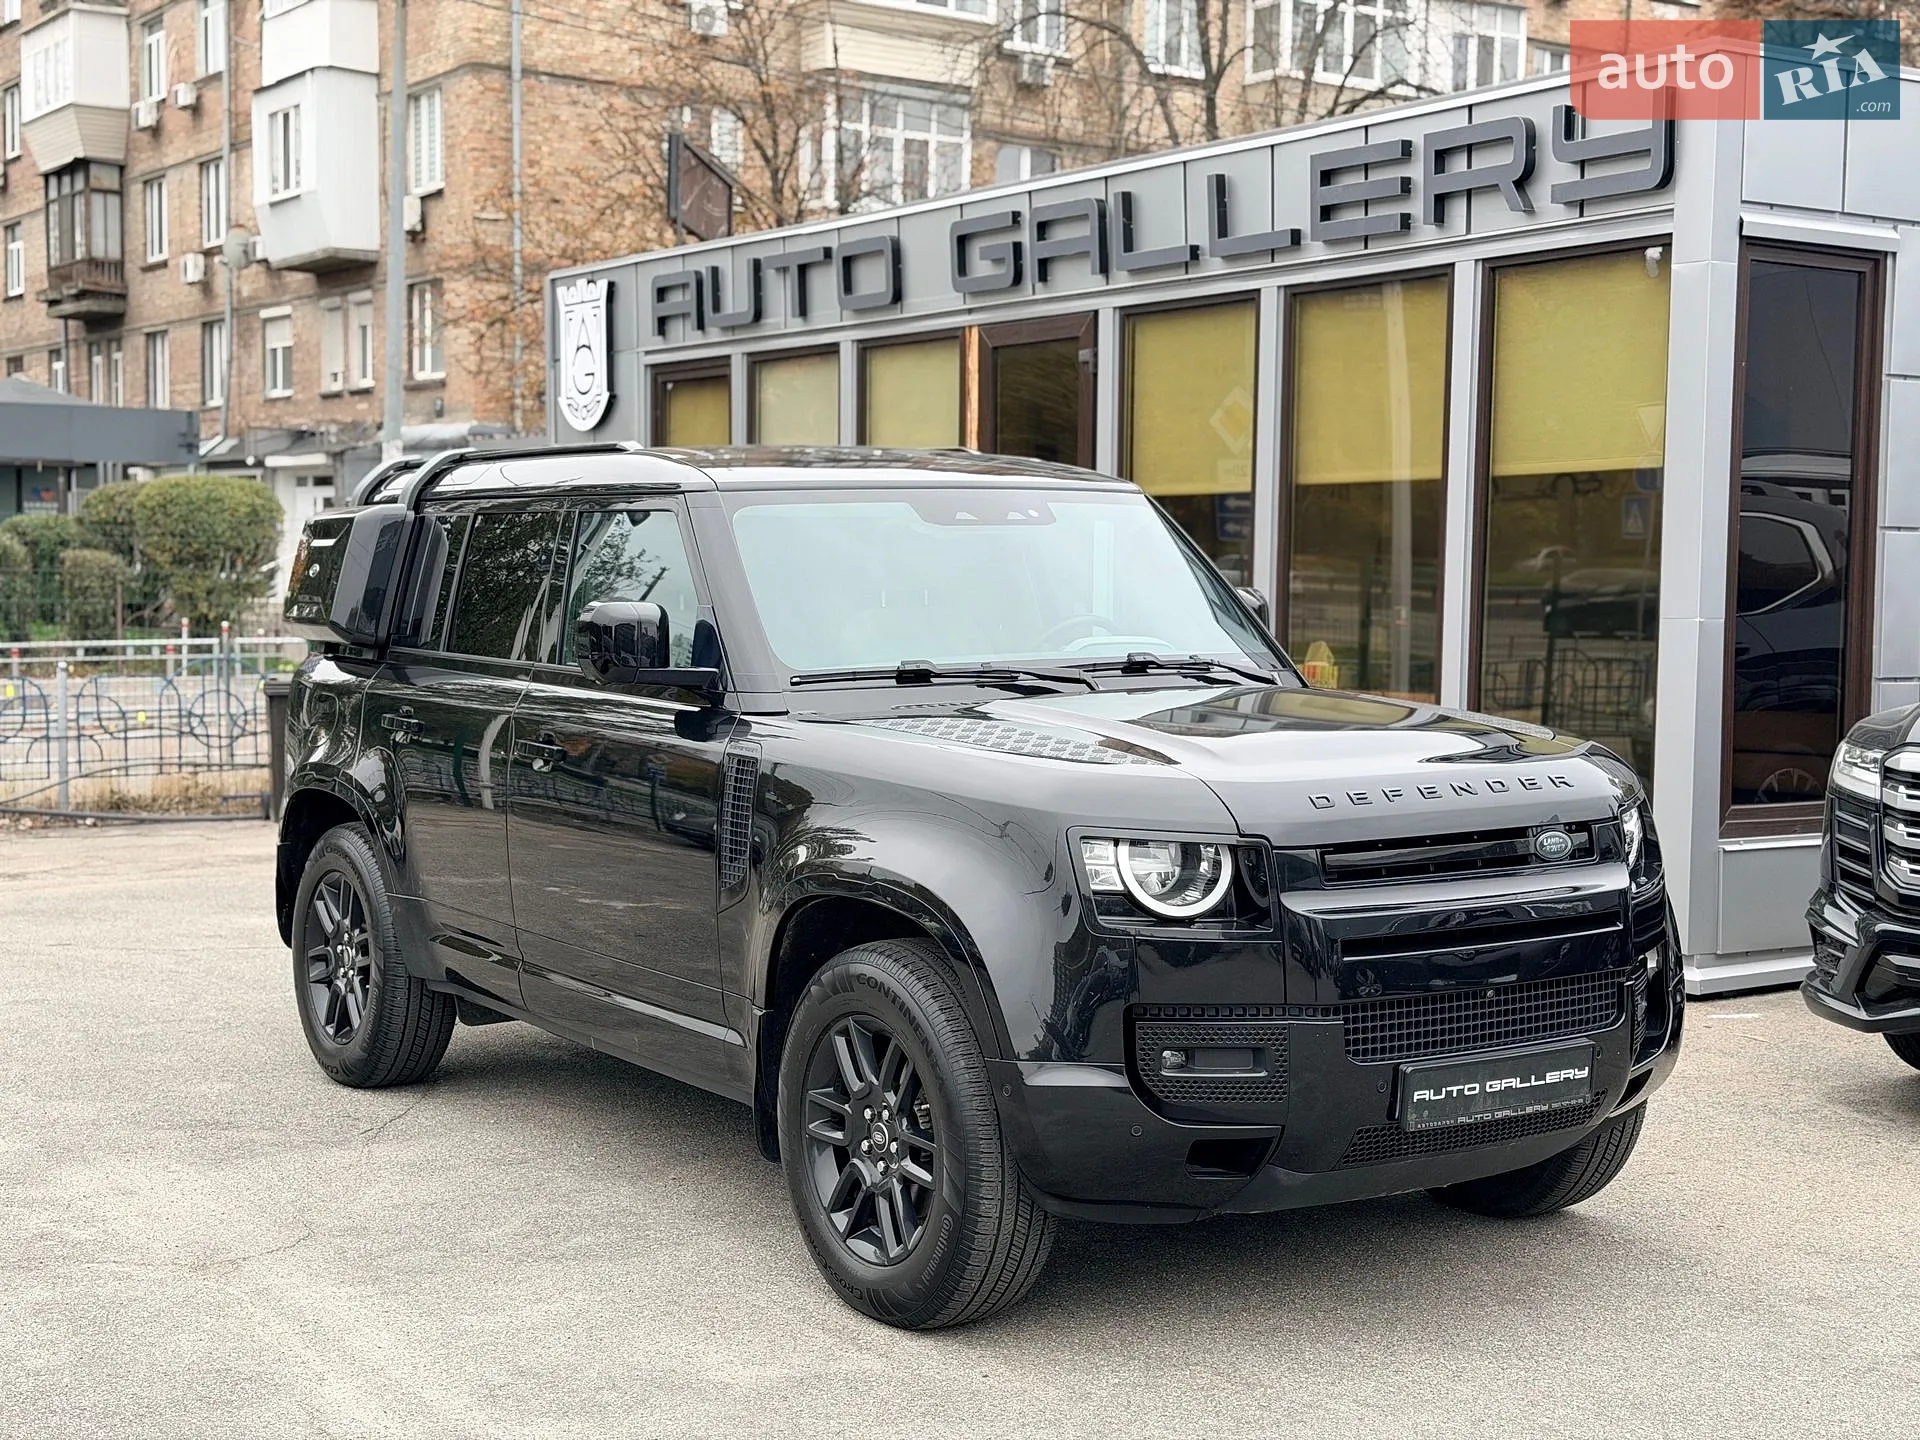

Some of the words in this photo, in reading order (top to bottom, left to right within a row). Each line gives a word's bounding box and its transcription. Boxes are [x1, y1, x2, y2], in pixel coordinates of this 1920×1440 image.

[652, 235, 902, 336] AUTO
[949, 86, 1677, 294] GALLERY
[1308, 775, 1575, 809] DEFENDER
[1413, 1083, 1480, 1103] AUTO
[1485, 1066, 1589, 1093] GALLERY
[1457, 1112, 1492, 1124] AUTO
[1494, 1103, 1549, 1118] GALLERY
[921, 1213, 954, 1286] Continental
